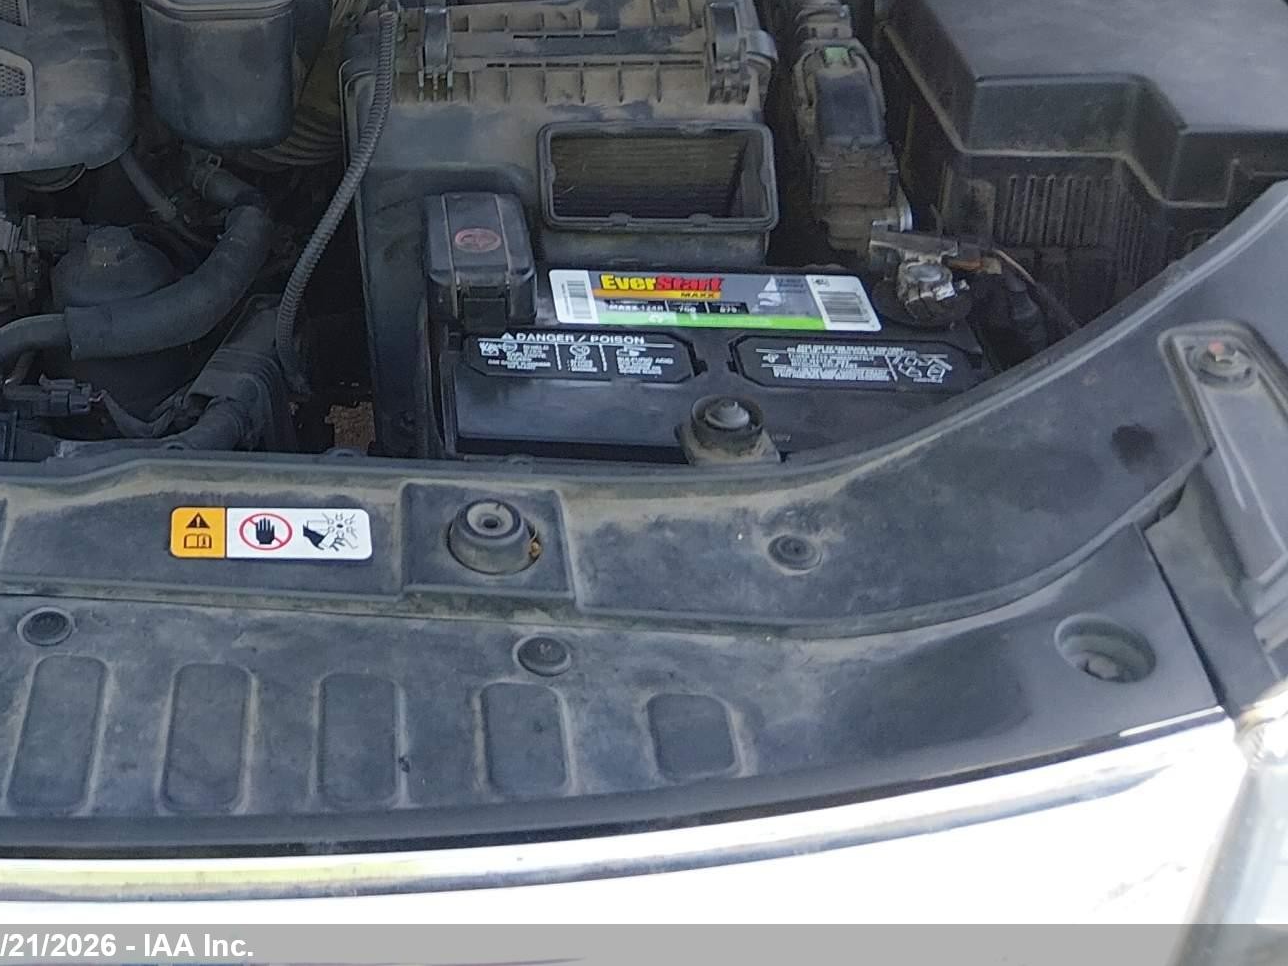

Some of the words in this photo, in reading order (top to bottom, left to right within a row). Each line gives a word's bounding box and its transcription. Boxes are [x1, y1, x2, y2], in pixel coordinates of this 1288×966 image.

[600, 274, 723, 291] EverStart
[516, 333, 575, 343] DANGER
[590, 335, 645, 345] POISON
